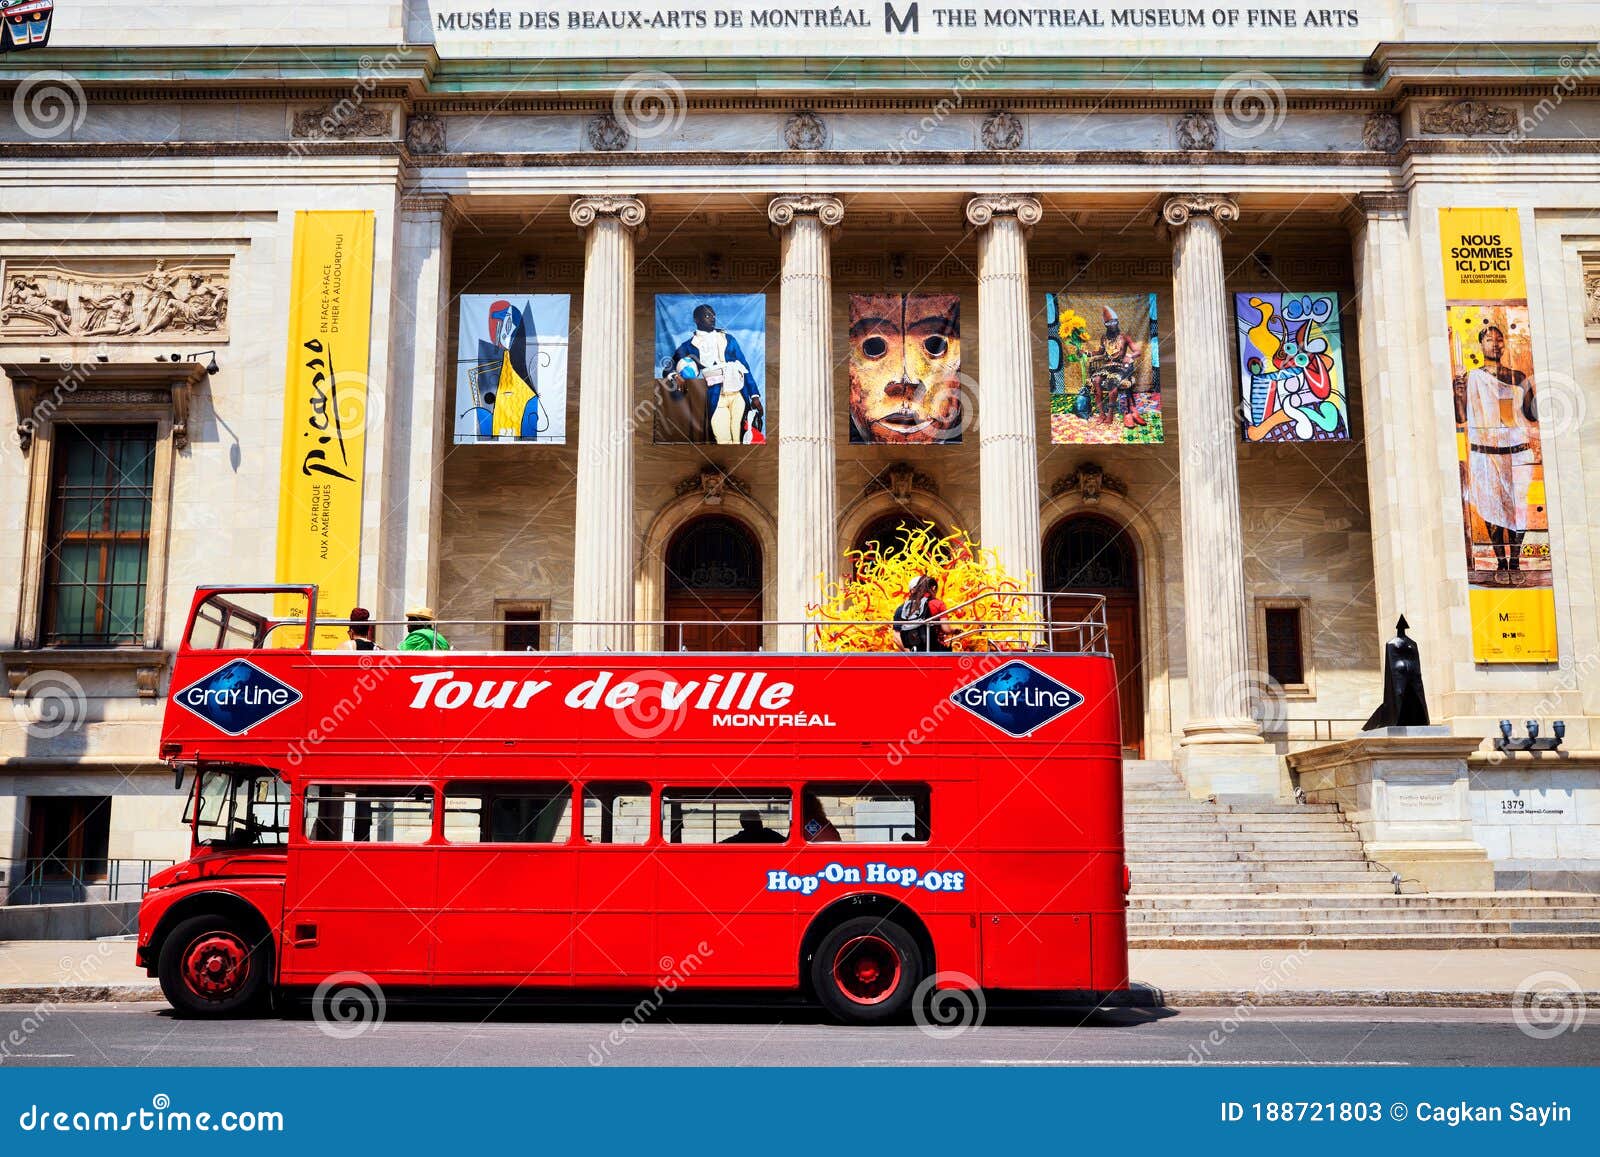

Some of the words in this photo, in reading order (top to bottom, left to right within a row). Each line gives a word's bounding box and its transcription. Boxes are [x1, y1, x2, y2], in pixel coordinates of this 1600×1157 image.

[437, 7, 512, 30] MUSÉE
[518, 11, 560, 30] DES
[567, 10, 707, 29] BEAUX-ARTS
[714, 10, 743, 28] DE
[750, 6, 871, 28] MONTRÉAL
[884, 2, 919, 33] M
[932, 9, 977, 27] THE
[983, 9, 1105, 27] MONTREAL
[1111, 9, 1205, 27] MUSEUM
[1211, 9, 1240, 27] OF
[1247, 9, 1297, 27] FINE
[1303, 9, 1360, 27] ARTS
[1461, 235, 1501, 246] NOUS
[1451, 247, 1513, 259] SOMMES
[333, 233, 344, 294] AUJOURD'HUI
[1455, 260, 1476, 273] ICI,
[1479, 260, 1511, 271] D'ICI
[320, 322, 328, 333] EN
[331, 305, 340, 333] D'HIER
[310, 484, 321, 532] D'AFRIQUE
[320, 540, 328, 560] AUX
[1498, 613, 1509, 621] M
[408, 670, 553, 709] Tour
[564, 671, 639, 709] de
[659, 671, 795, 711] ville
[712, 711, 837, 727] MONTRÉAL
[1501, 800, 1525, 810] 1379
[767, 863, 861, 895] Hop-On
[866, 863, 965, 891] Hop-Off
